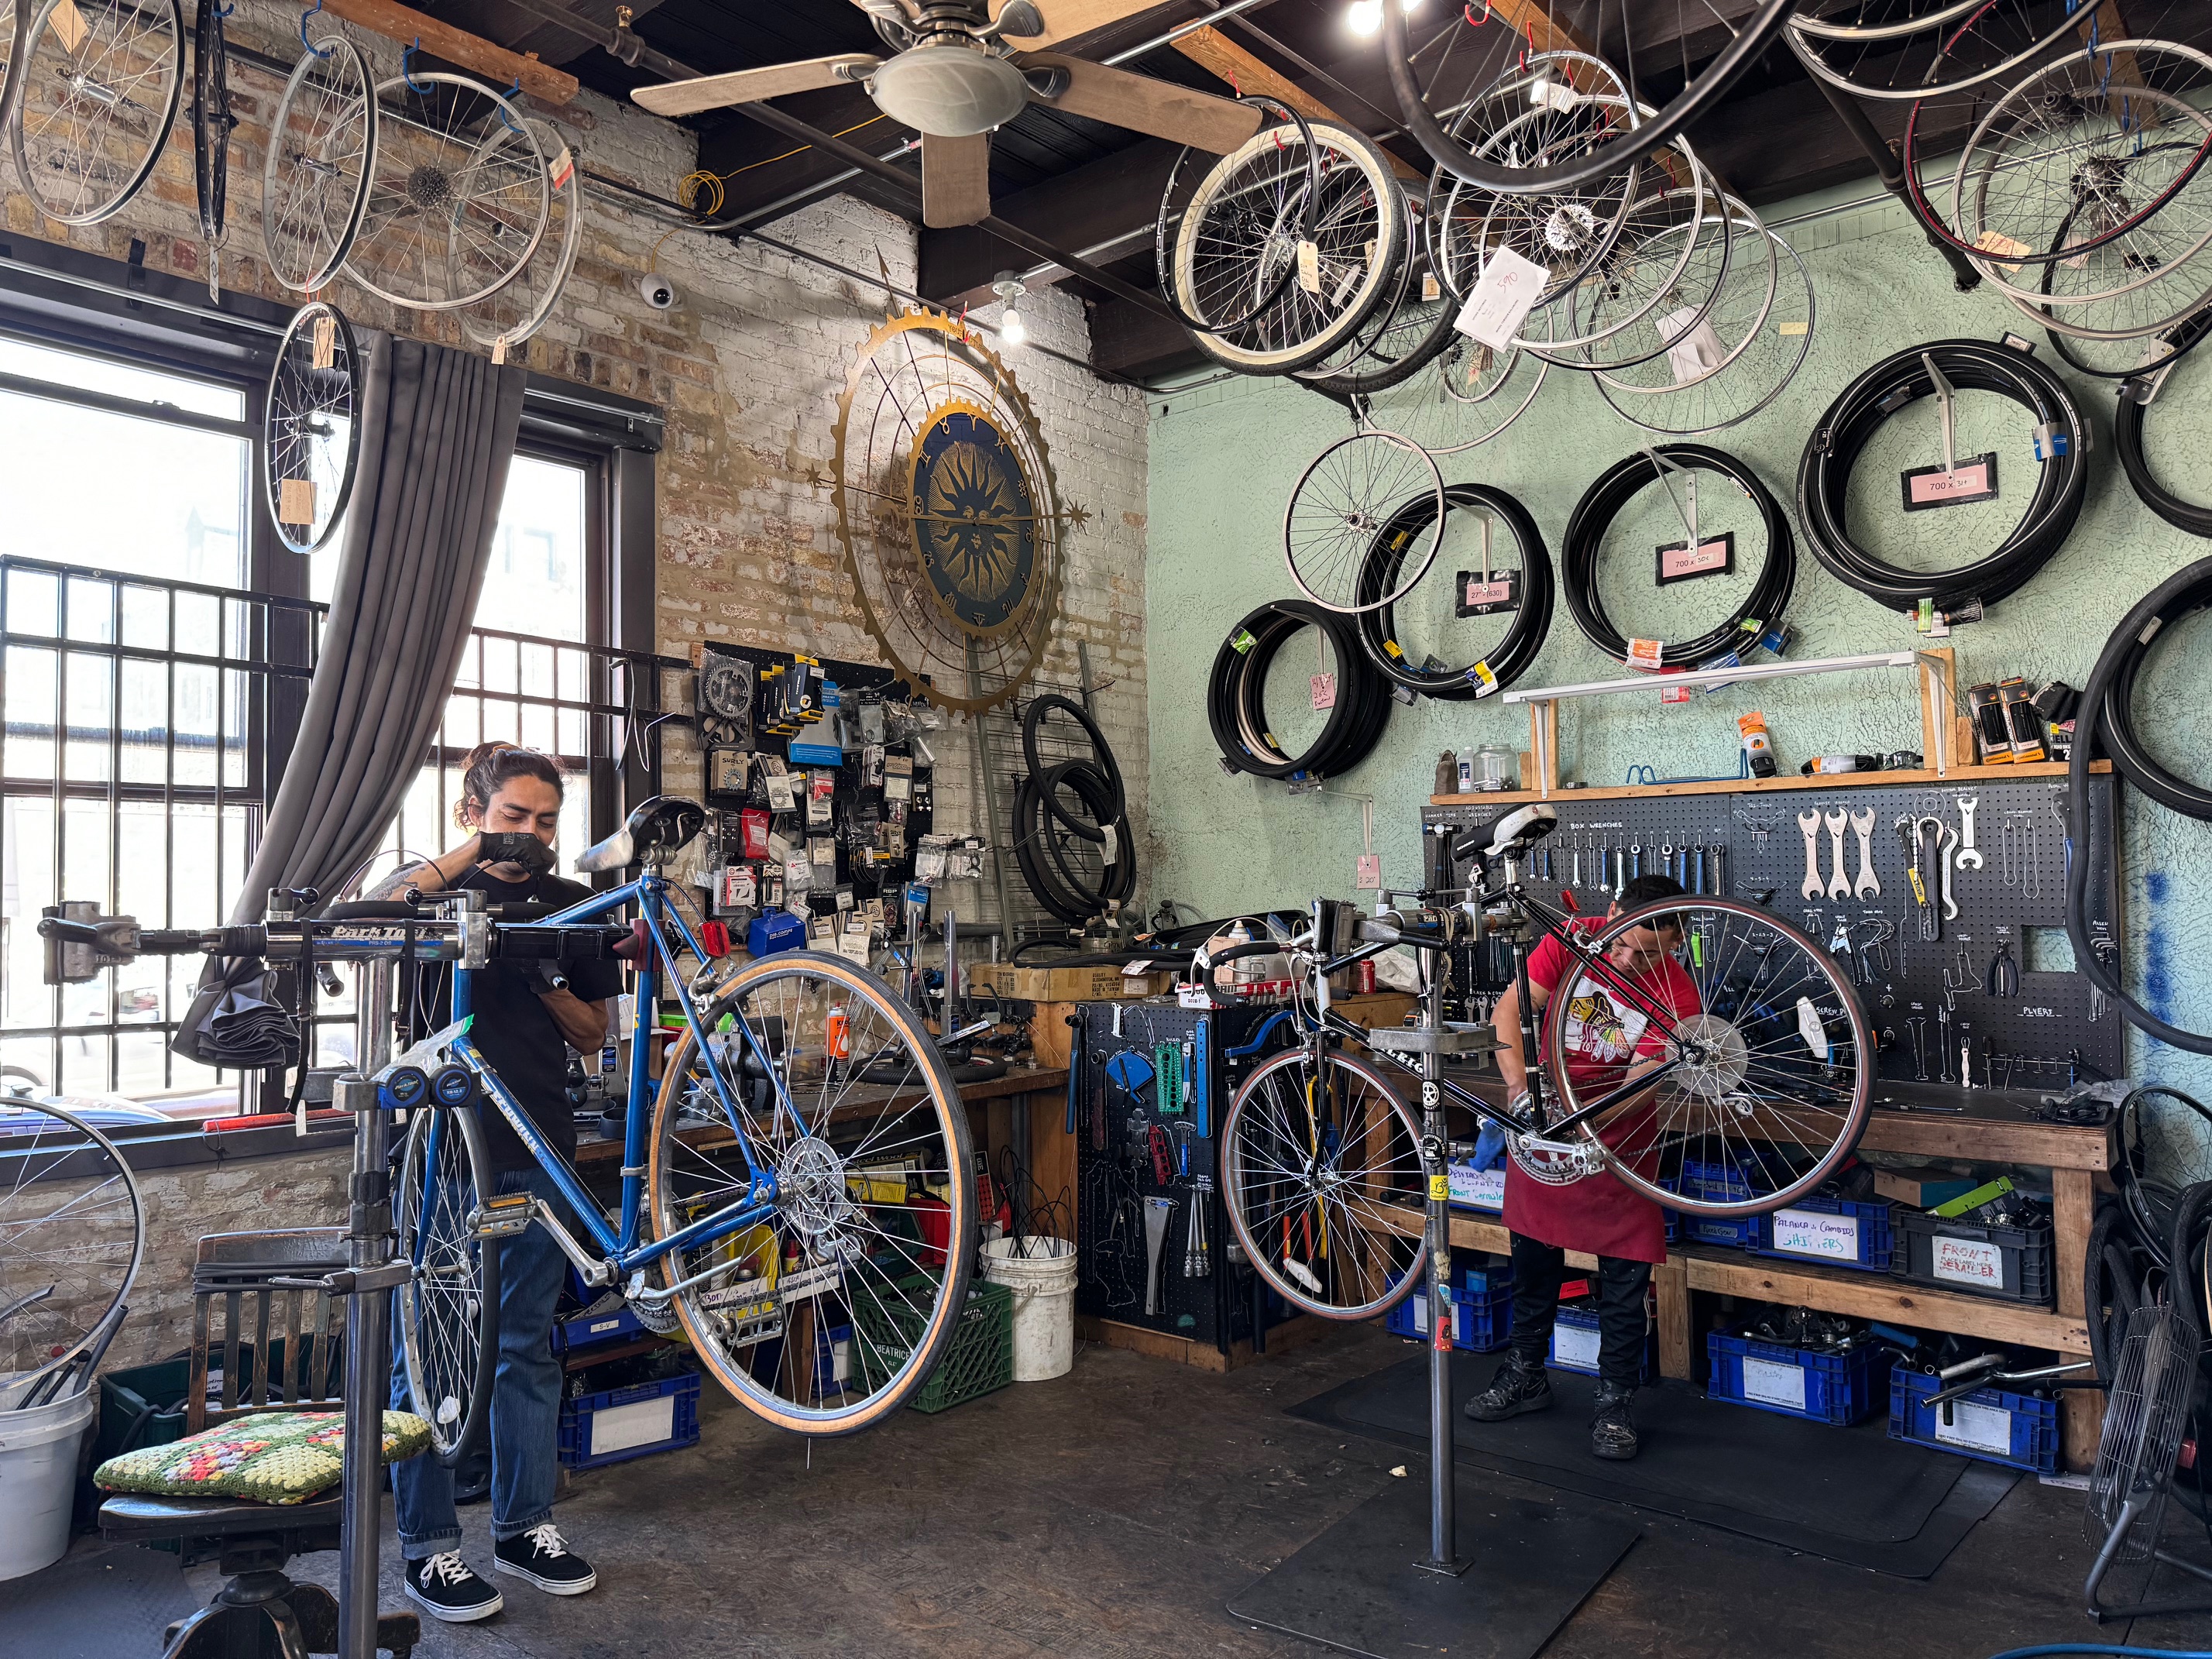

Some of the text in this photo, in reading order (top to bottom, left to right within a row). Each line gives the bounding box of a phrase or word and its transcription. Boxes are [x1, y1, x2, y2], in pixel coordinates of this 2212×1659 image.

[1497, 272, 1518, 294] 590
[1930, 481, 1946, 490] 700
[331, 926, 380, 938] Park
[1448, 1186, 1469, 1197] FRONT
[1774, 1215, 1808, 1229] PALANCA
[1942, 1243, 1992, 1261] FRONT
[877, 1345, 910, 1360] BEATRICE
